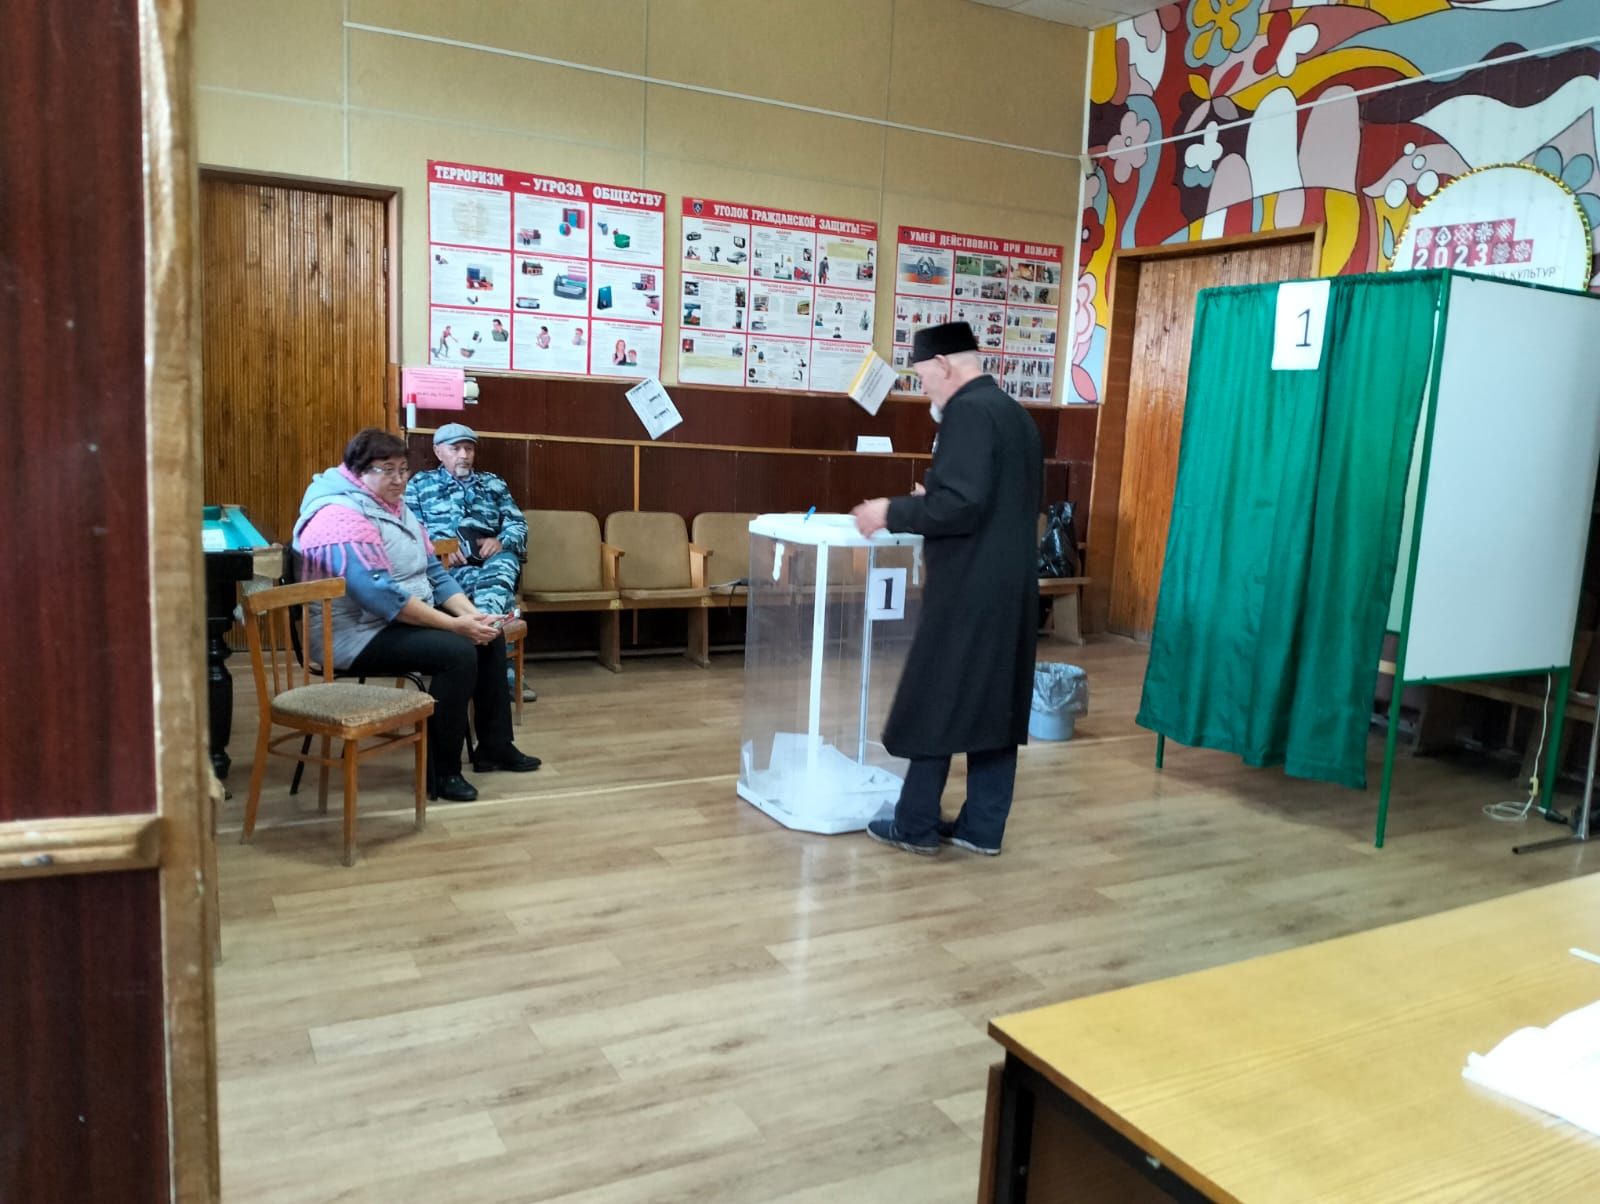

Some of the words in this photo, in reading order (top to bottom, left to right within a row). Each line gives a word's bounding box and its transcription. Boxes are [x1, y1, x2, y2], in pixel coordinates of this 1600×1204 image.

[434, 165, 504, 187] ТЕРРОРИЗМ
[533, 178, 584, 198] УГРОЗА
[592, 186, 662, 207] ОБЩЕСТВУ
[713, 204, 749, 219] УГОЛОК
[751, 210, 817, 229] ГРАЖДАНСКОЙ
[819, 218, 860, 235] ЗАЩИТЫ
[909, 230, 936, 244] УМЕЙ
[939, 233, 1000, 251] ДЕЙСТВОВАТЬ
[1003, 241, 1021, 254] ПРИ
[1024, 244, 1058, 258] ПОЖАРЕ
[1413, 243, 1489, 269] 2023
[1295, 308, 1312, 348] 1
[877, 576, 898, 610] 1
